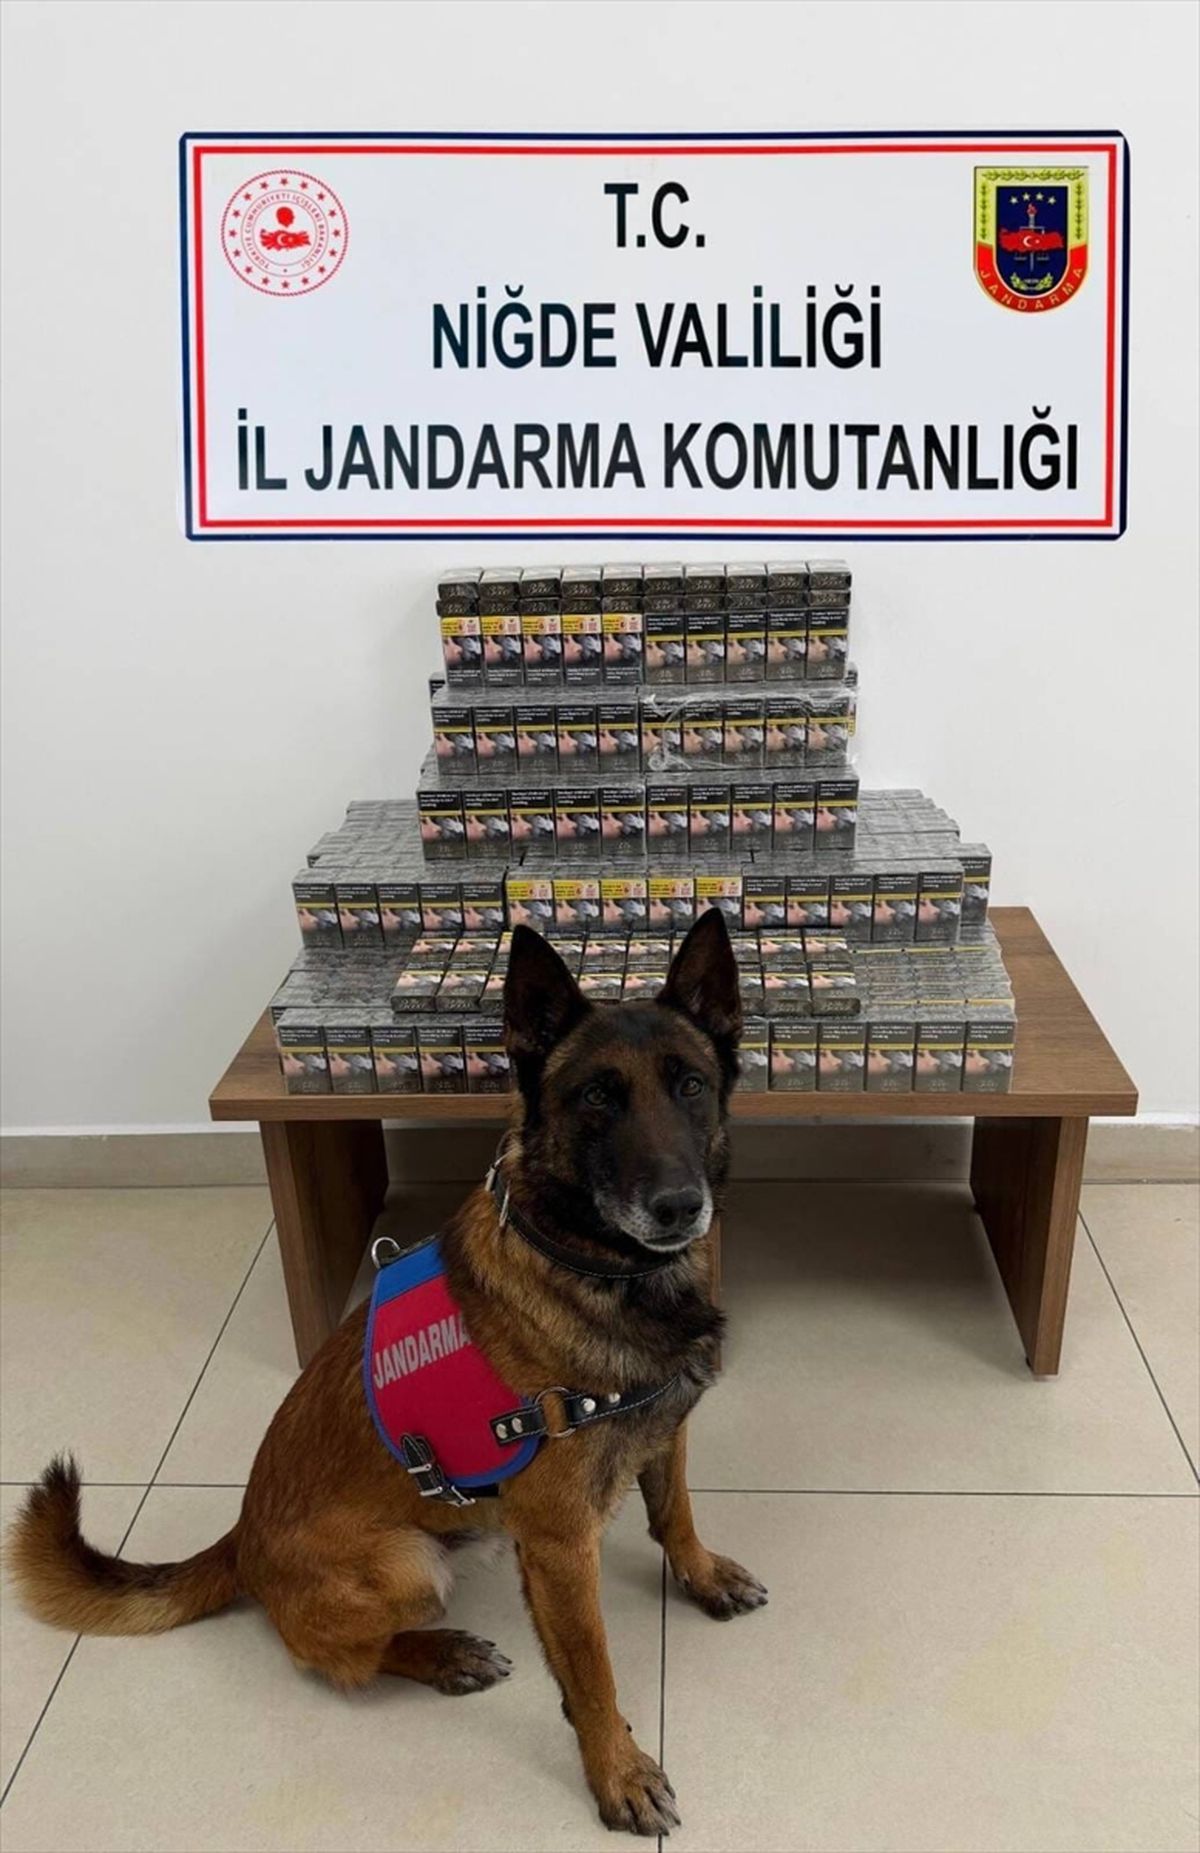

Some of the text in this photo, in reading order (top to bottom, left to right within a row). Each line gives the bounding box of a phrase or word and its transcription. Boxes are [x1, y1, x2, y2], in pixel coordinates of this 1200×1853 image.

[604, 182, 705, 248] T.C.
[434, 284, 881, 369] NİĞDE VALİLİĞİ
[980, 268, 1083, 310] JANDARMA
[238, 406, 1077, 490] İL JANDARMA KOMUTANLIĞI
